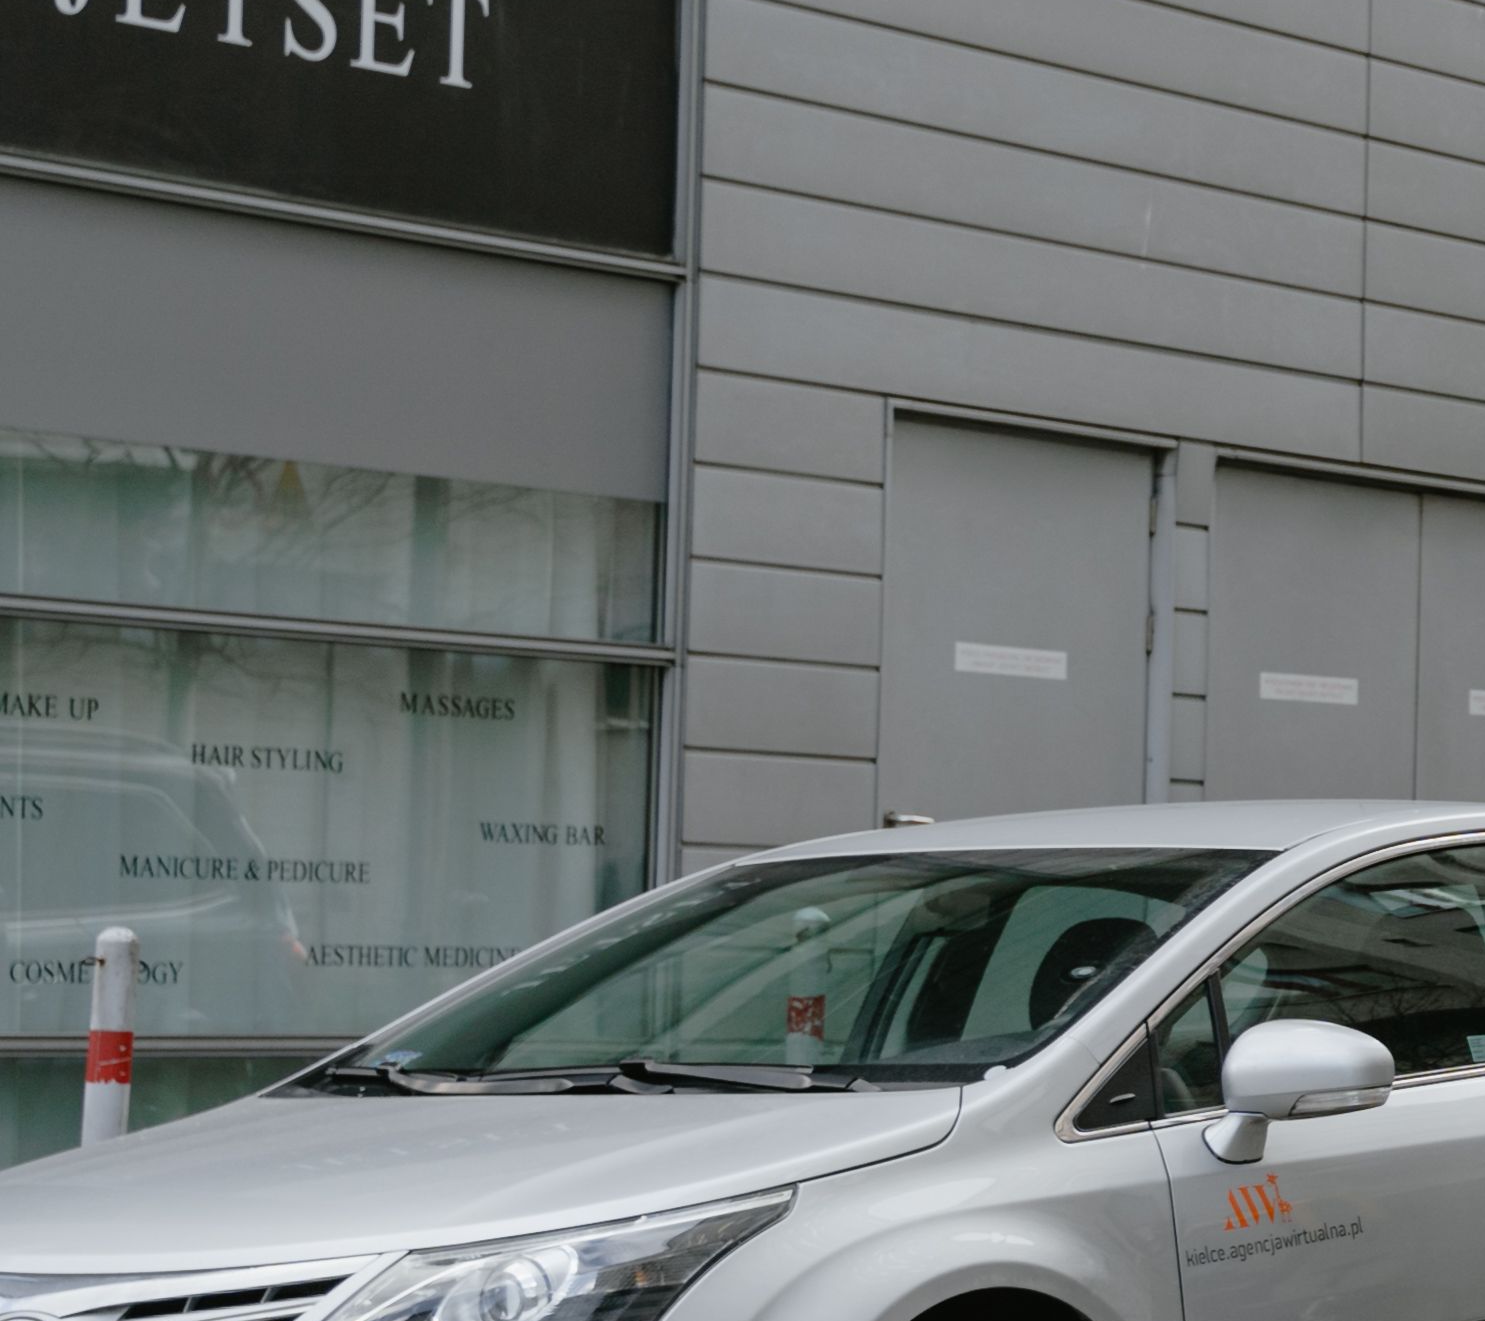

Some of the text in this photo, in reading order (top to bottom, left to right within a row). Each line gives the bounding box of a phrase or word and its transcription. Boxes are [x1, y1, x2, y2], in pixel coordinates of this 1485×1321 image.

[69, 697, 100, 721] UP
[400, 691, 517, 721] MASSAGES
[191, 743, 344, 774] HAIR STYLING
[479, 821, 607, 847] WAXING BAR
[119, 854, 371, 884] MANICURE & PEDICURE
[304, 944, 414, 967] AESTHETIC
[1185, 1216, 1364, 1268] kielce.agencjawirtualna.pl
